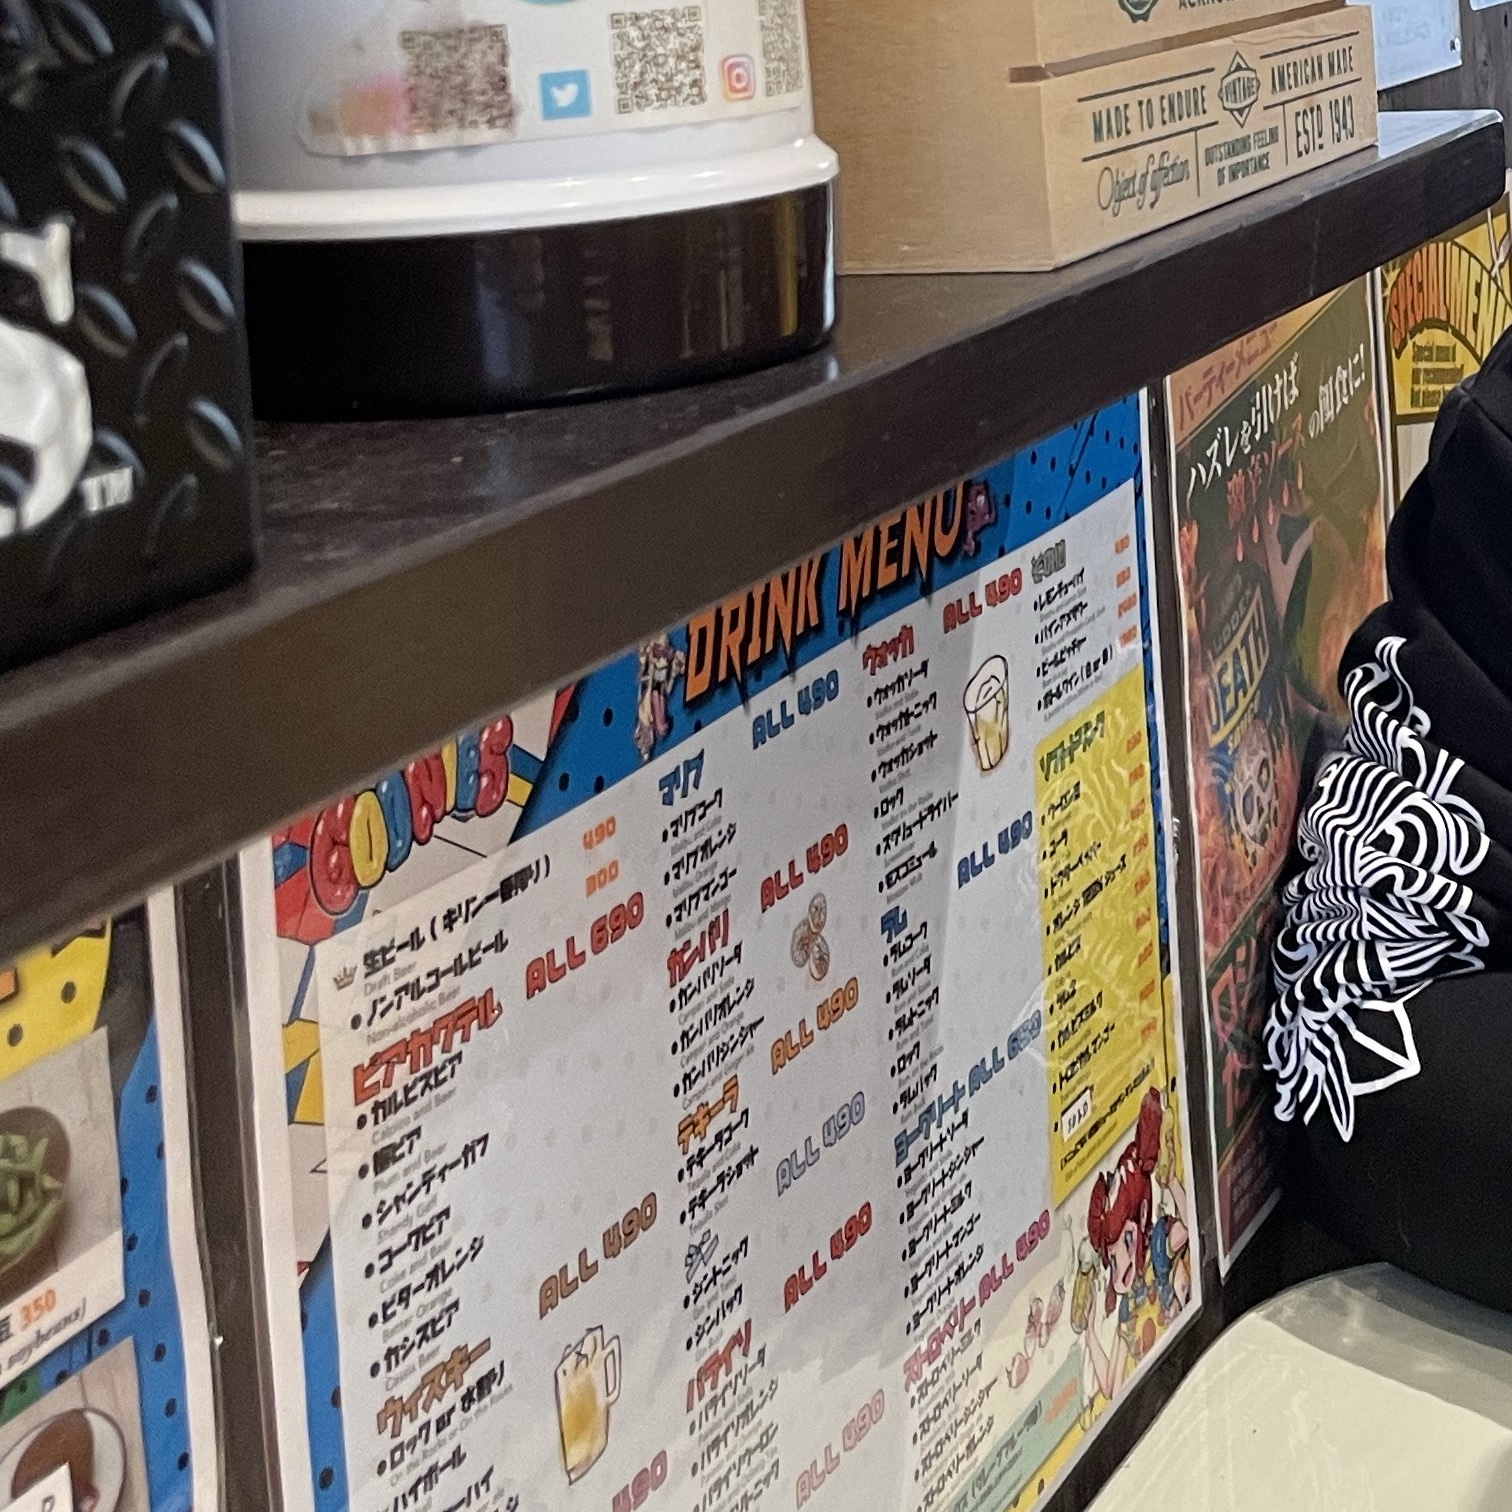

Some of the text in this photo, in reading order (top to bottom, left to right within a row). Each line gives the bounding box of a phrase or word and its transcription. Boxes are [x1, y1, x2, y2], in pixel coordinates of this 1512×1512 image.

[1271, 46, 1354, 95] AMERICAN MADE
[1092, 85, 1207, 144] MADE TO ENDURE
[685, 480, 964, 704] DRINK MENU
[942, 591, 982, 633] ALL
[984, 567, 1022, 607] 490
[751, 699, 794, 749] ALL
[797, 669, 839, 715] 490
[879, 786, 904, 817] ロック
[759, 859, 804, 913] ALL
[805, 823, 848, 873] 490
[956, 841, 995, 888] ALL
[997, 810, 1032, 854] 490
[367, 929, 508, 1025] ノンアルコールビール
[525, 936, 586, 999] ALL
[590, 891, 644, 954] 690
[676, 1077, 739, 1155] テキーラ
[770, 1018, 814, 1075] ALL
[816, 976, 858, 1030] 490
[896, 1040, 920, 1074] ロック
[967, 1046, 1005, 1097] ALL
[775, 1135, 820, 1197] ALL
[821, 1090, 865, 1147] 490
[378, 1205, 450, 1273] コークビア
[381, 1236, 484, 1323] ビターオレンジ
[783, 1250, 827, 1312] ALL
[829, 1201, 872, 1260] 490
[978, 1252, 1014, 1307] ALL
[1015, 1209, 1050, 1261] 490
[20, 1287, 57, 1333] 350
[376, 1338, 490, 1438] ウィスキー
[538, 1248, 598, 1319] ALL
[602, 1192, 657, 1258] 490
[389, 1418, 431, 1470] ロック
[795, 1388, 885, 1509] ALL 490
